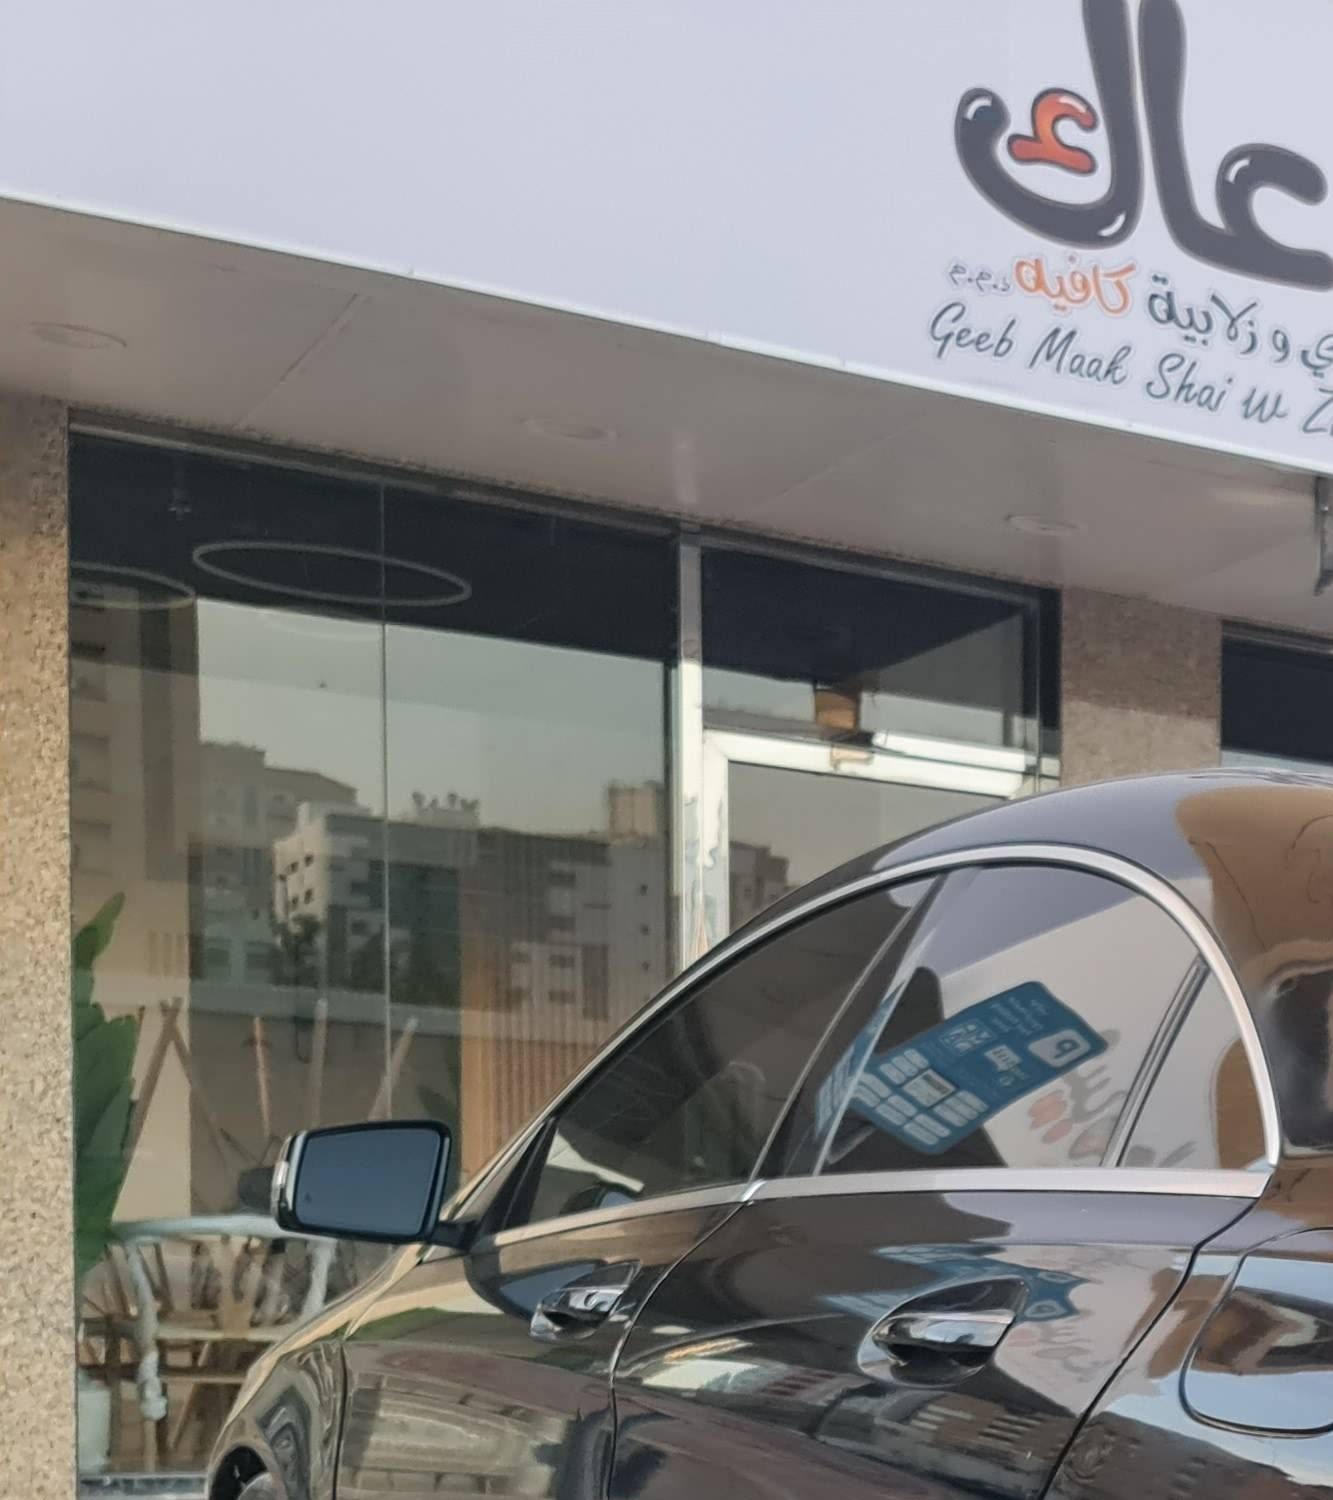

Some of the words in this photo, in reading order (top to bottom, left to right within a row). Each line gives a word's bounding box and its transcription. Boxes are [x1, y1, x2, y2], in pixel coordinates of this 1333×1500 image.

[1014, 255, 1137, 314] كافيه
[930, 302, 1017, 358] Geeb
[1028, 327, 1132, 385] Maak
[1146, 352, 1234, 412] Shai
[1271, 329, 1290, 363] و
